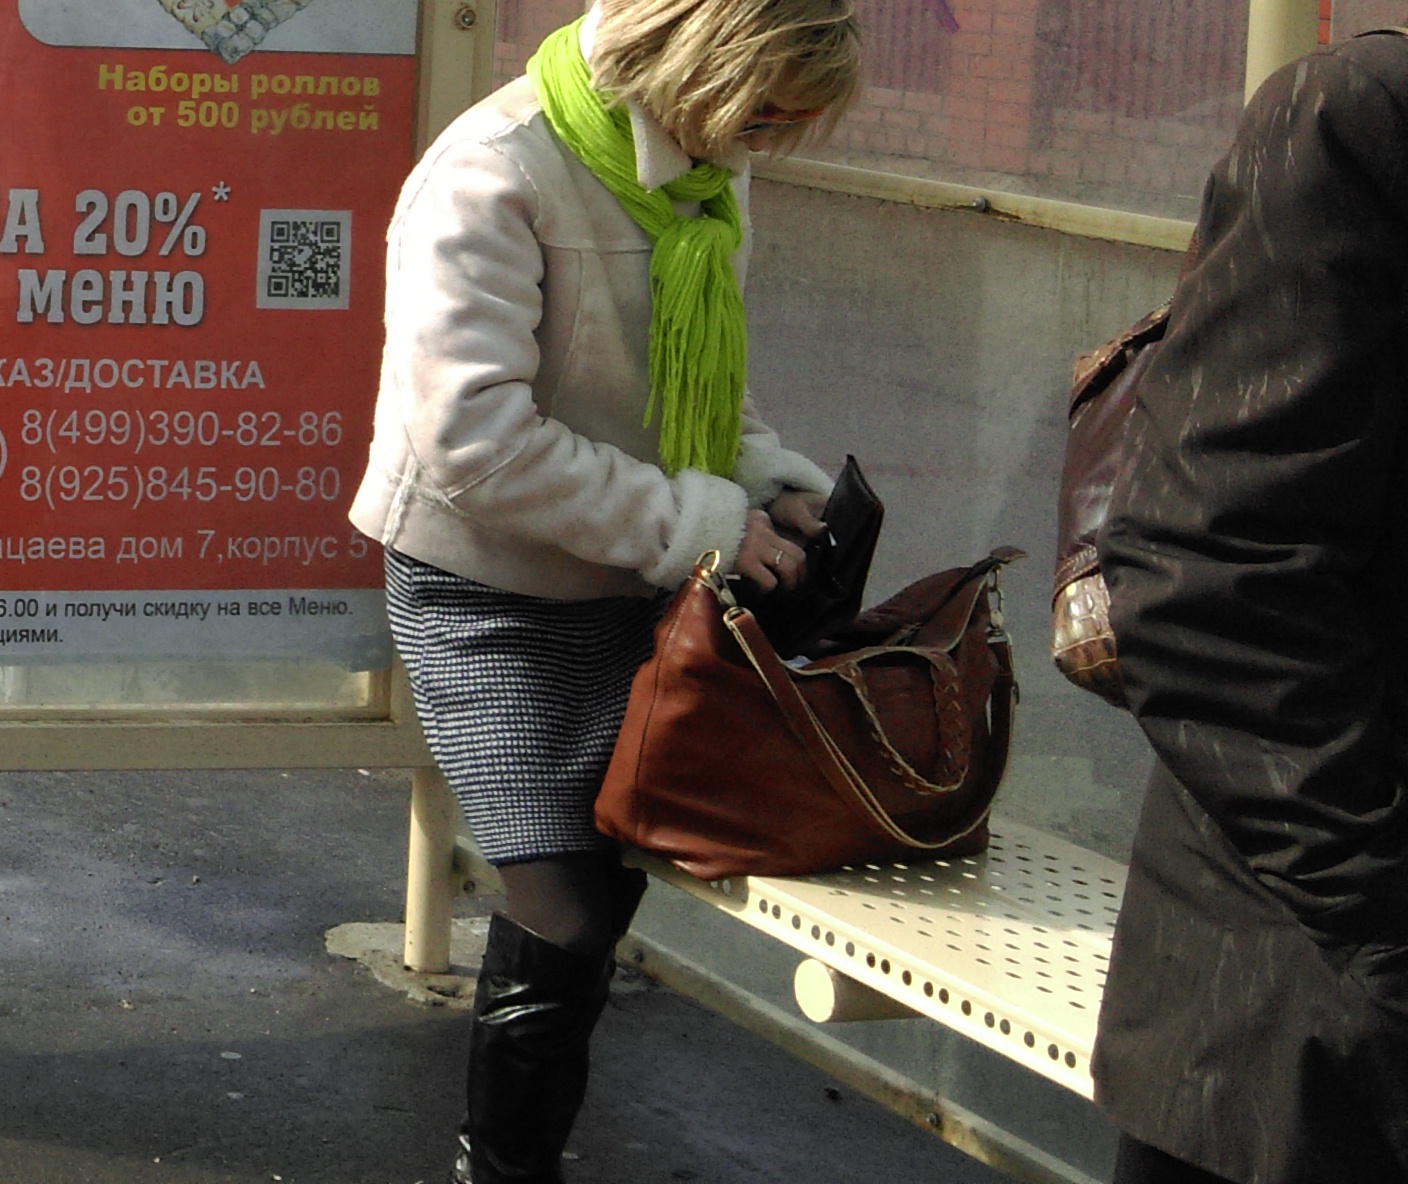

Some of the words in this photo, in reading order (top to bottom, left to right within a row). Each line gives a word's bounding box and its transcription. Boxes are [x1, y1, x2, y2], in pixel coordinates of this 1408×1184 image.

[98, 64, 239, 98] Наборы
[251, 72, 381, 98] роллов
[127, 105, 165, 127] от
[177, 101, 239, 128] 500
[251, 103, 379, 135] рублей
[17, 268, 206, 326] меню
[21, 409, 343, 454] 8(499)390-82-86
[20, 466, 341, 510] 8(925)845-90-80
[116, 536, 183, 564] дом
[197, 529, 337, 566] 7,корпус
[349, 530, 369, 560] 5
[45, 603, 57, 616] и
[64, 602, 136, 621] получи
[143, 602, 210, 621] скидку
[217, 602, 241, 616] на
[248, 601, 282, 615] все
[288, 596, 354, 616] Меню.
